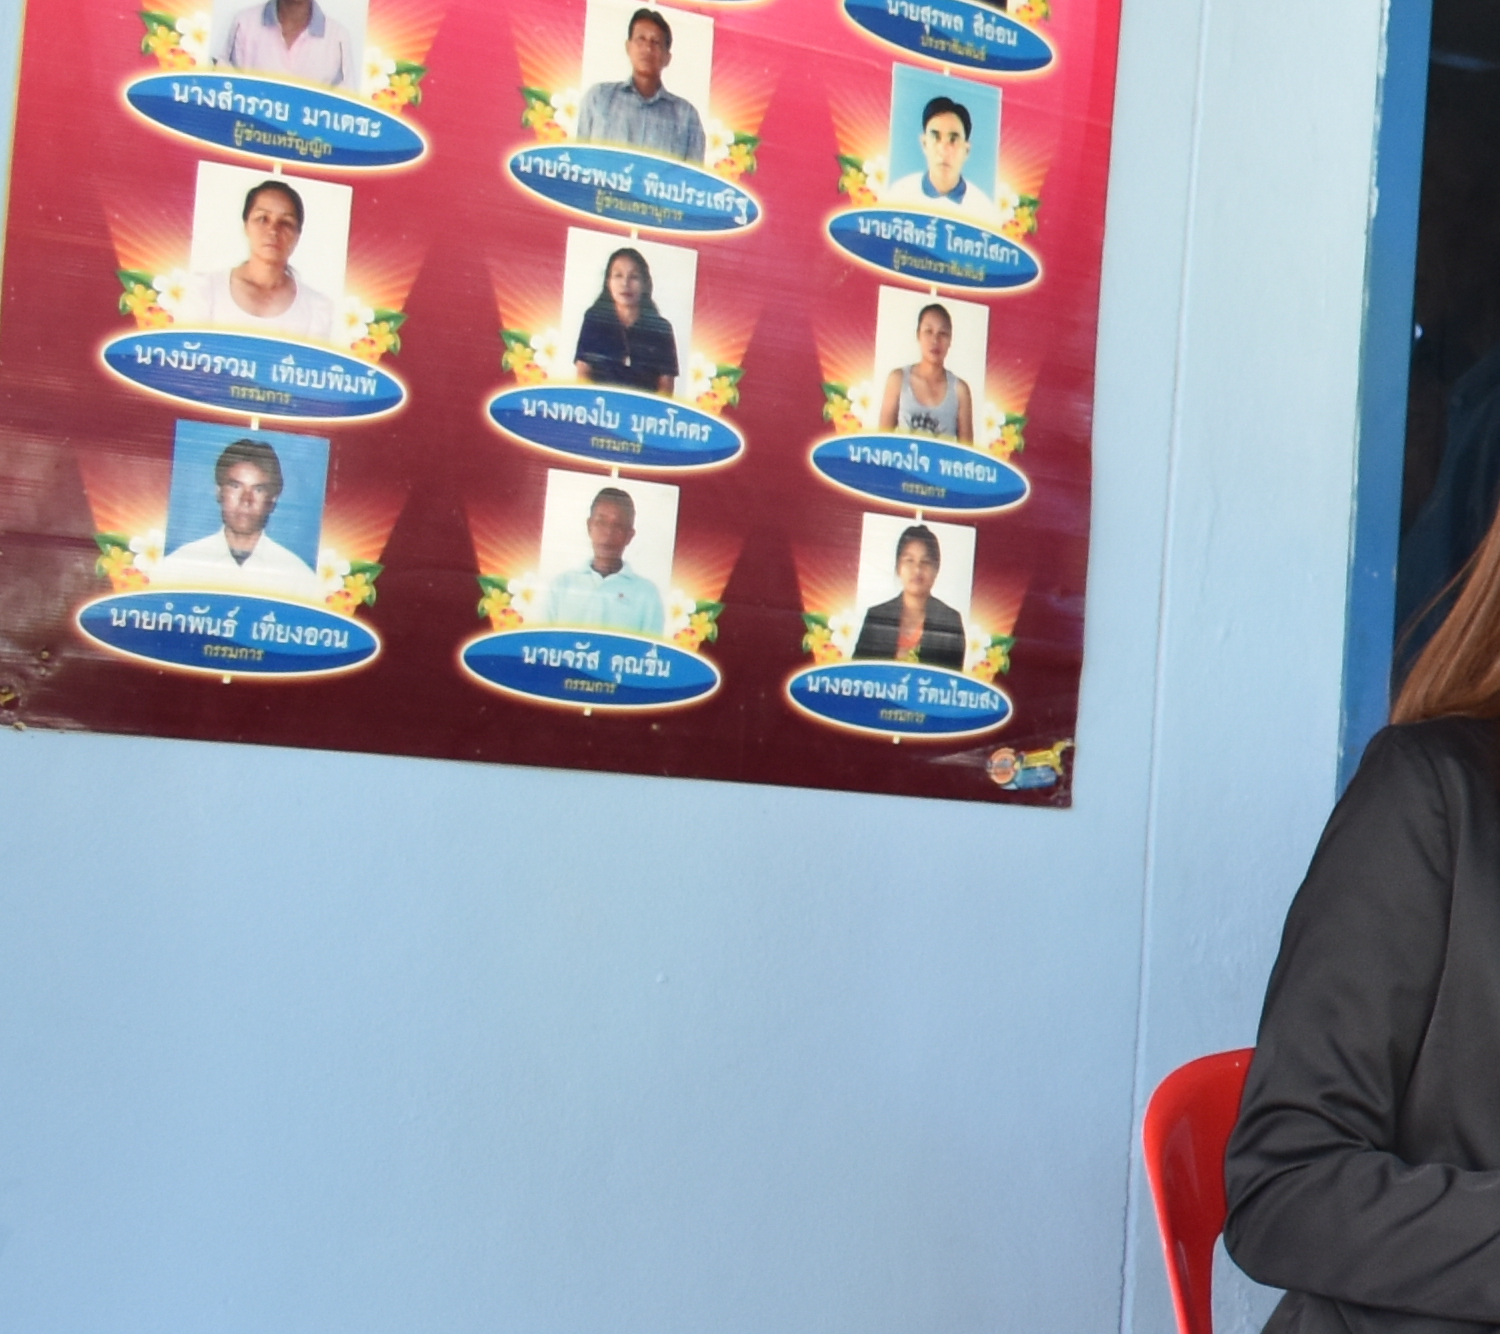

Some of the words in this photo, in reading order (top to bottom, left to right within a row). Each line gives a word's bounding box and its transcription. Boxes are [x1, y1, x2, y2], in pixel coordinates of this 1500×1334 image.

[171, 81, 290, 122] นางสำรวย
[643, 171, 750, 226] พิมประเสริฐ
[134, 341, 257, 380] นางบัวรวม
[521, 395, 620, 430] นางทองใบ
[849, 443, 931, 474] นางดวงใจ
[110, 602, 240, 639] นายคำพันธ์
[203, 642, 265, 662] กรรมการ
[522, 641, 601, 671] นายจรัส
